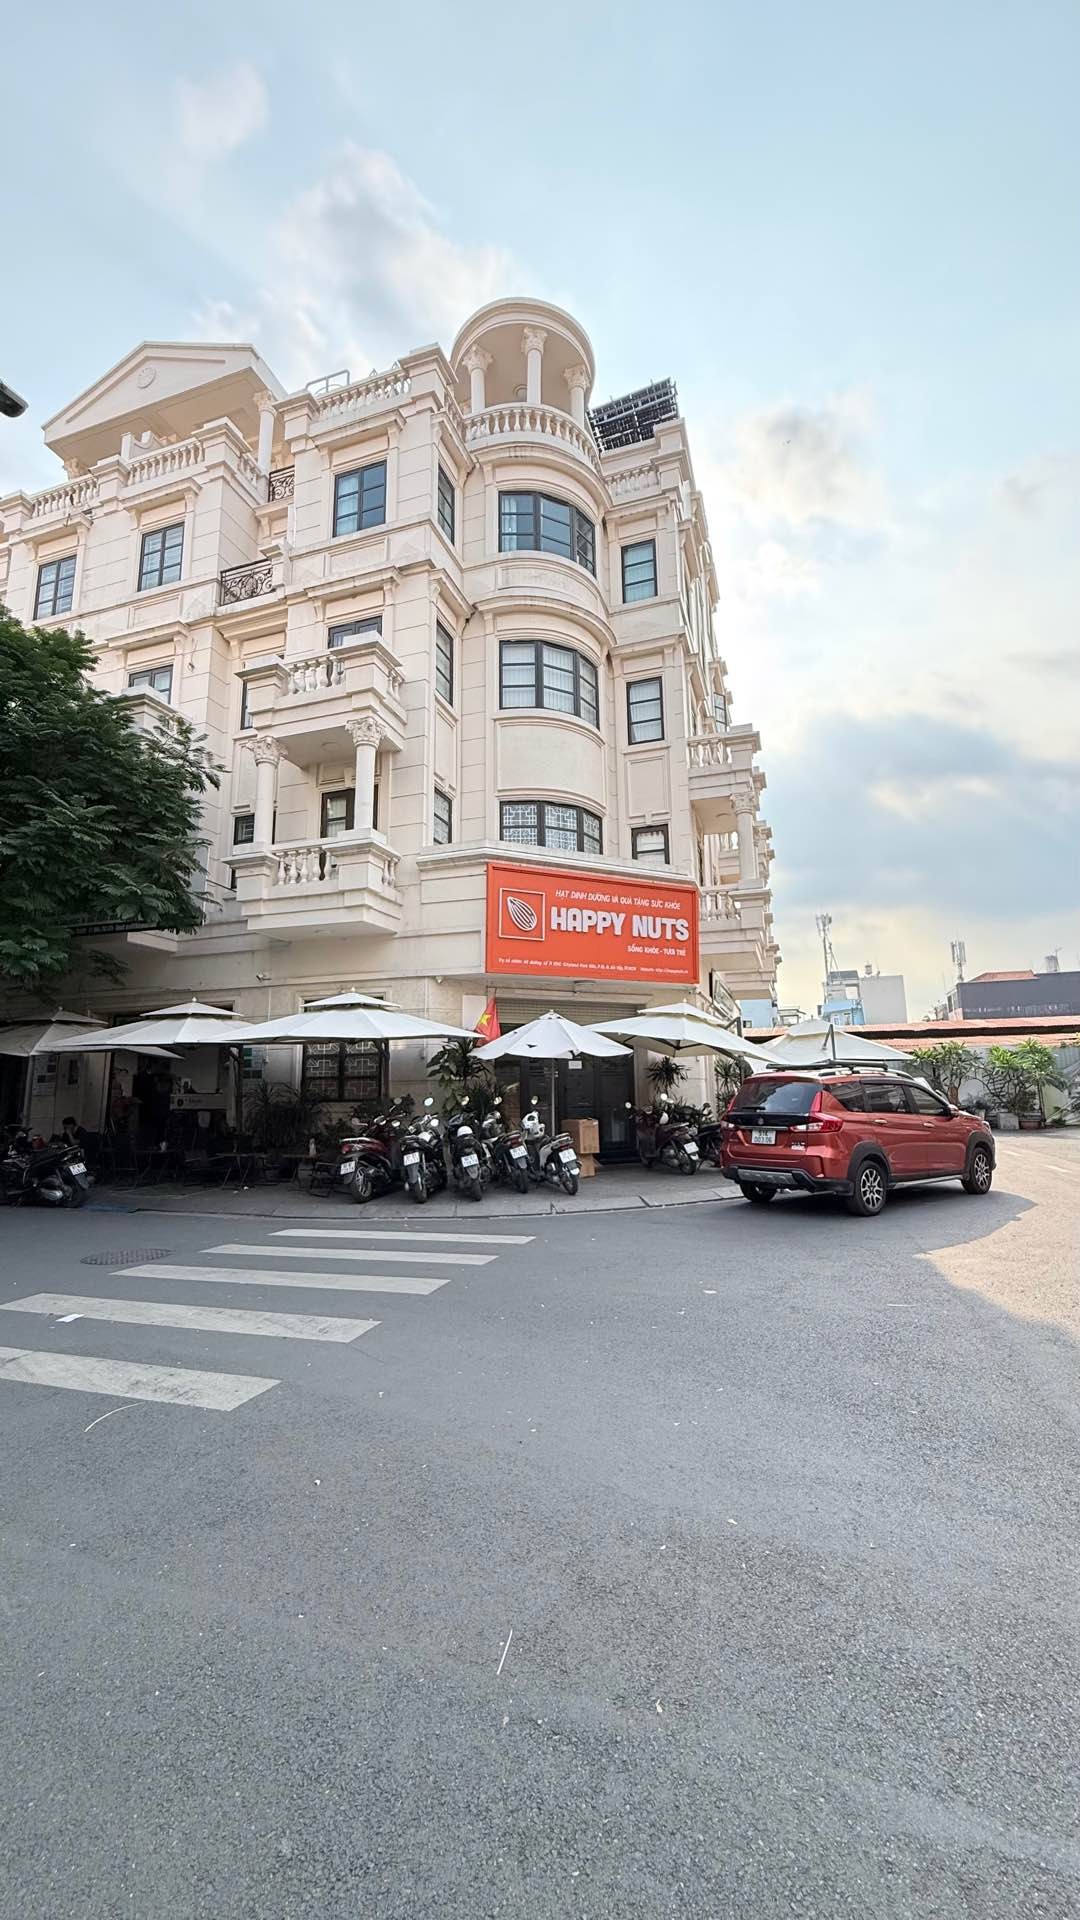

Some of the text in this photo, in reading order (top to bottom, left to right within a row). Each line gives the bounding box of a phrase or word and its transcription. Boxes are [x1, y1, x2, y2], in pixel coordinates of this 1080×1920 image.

[571, 890, 587, 900] DINH
[550, 906, 690, 941] HAPPY NUTS
